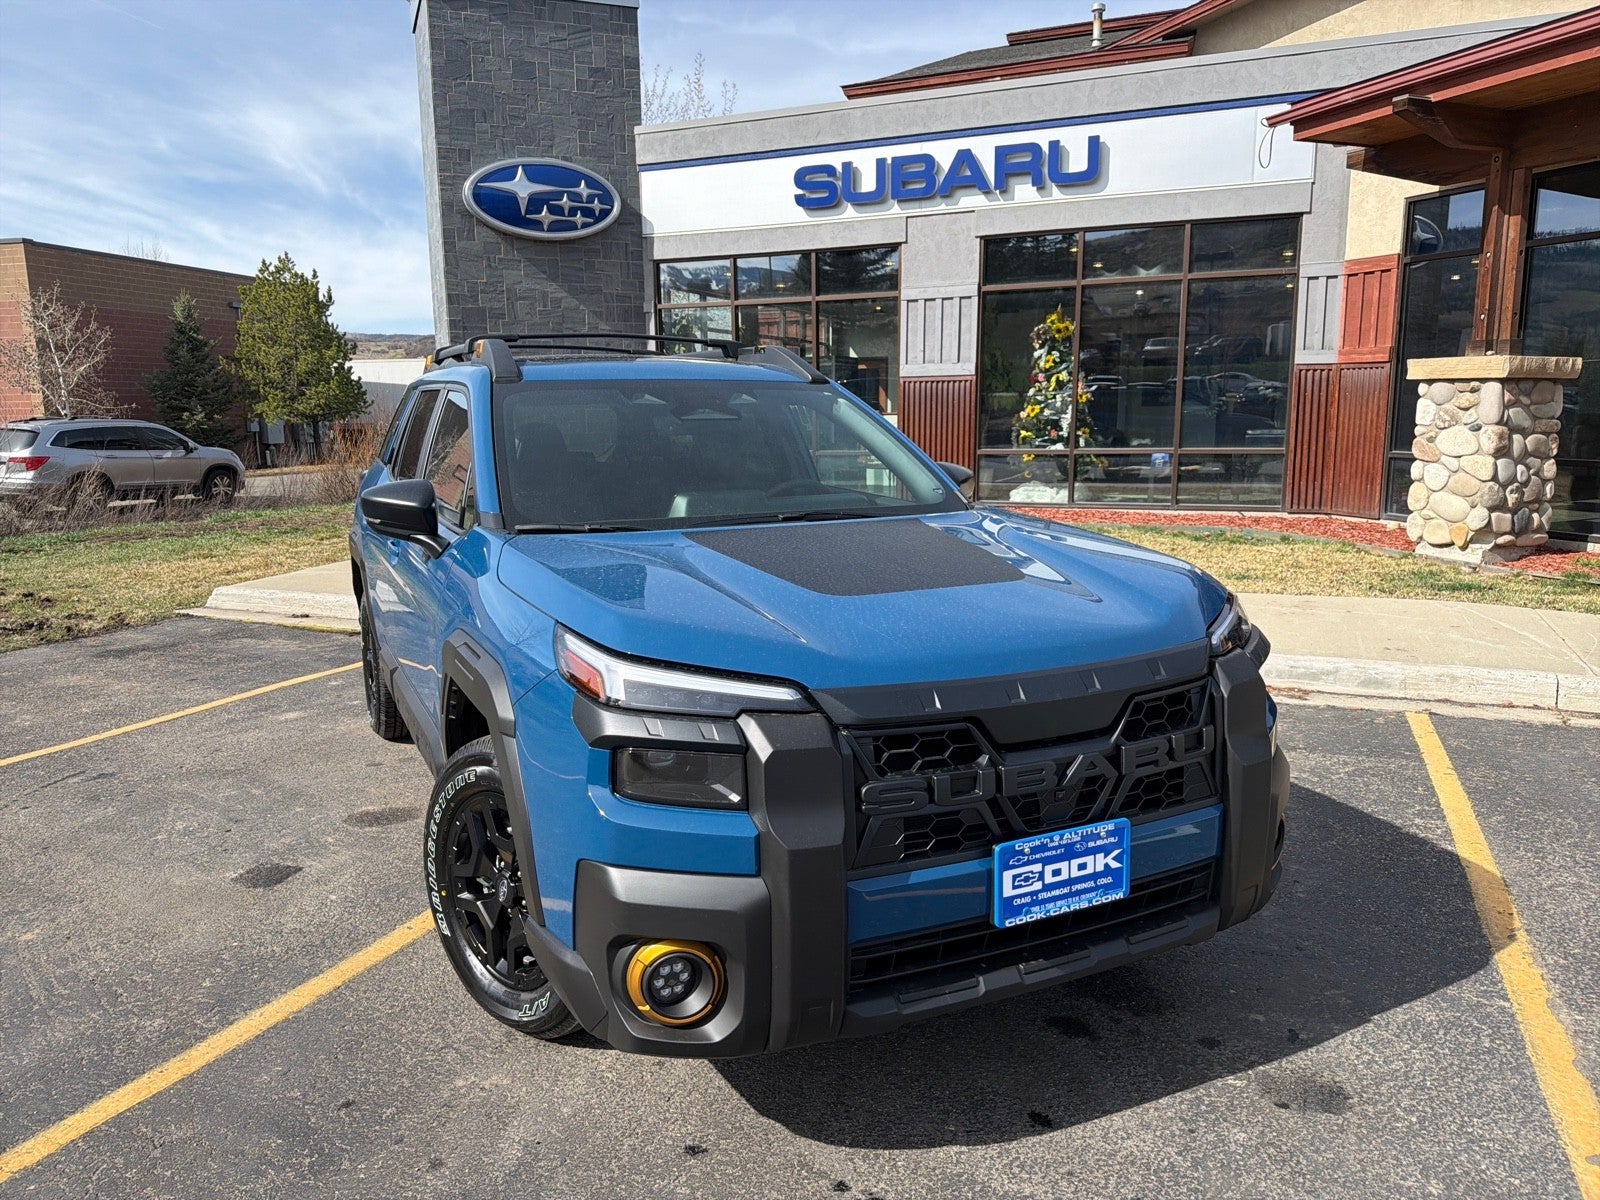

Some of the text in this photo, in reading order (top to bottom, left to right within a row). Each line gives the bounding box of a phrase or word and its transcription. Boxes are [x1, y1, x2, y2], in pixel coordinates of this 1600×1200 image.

[793, 134, 1101, 209] SUBARU
[860, 724, 1216, 814] SUBARU
[1015, 838, 1050, 850] Cook'n
[1063, 823, 1115, 839] ALTITUDE
[1087, 837, 1118, 848] SUBARU
[1029, 848, 1065, 860] CHEVROLET
[1003, 849, 1123, 897] COOK
[1013, 877, 1113, 906] CRAIG STEAMBOAT SPRINGS, COLO.
[518, 991, 551, 1017] A/T
